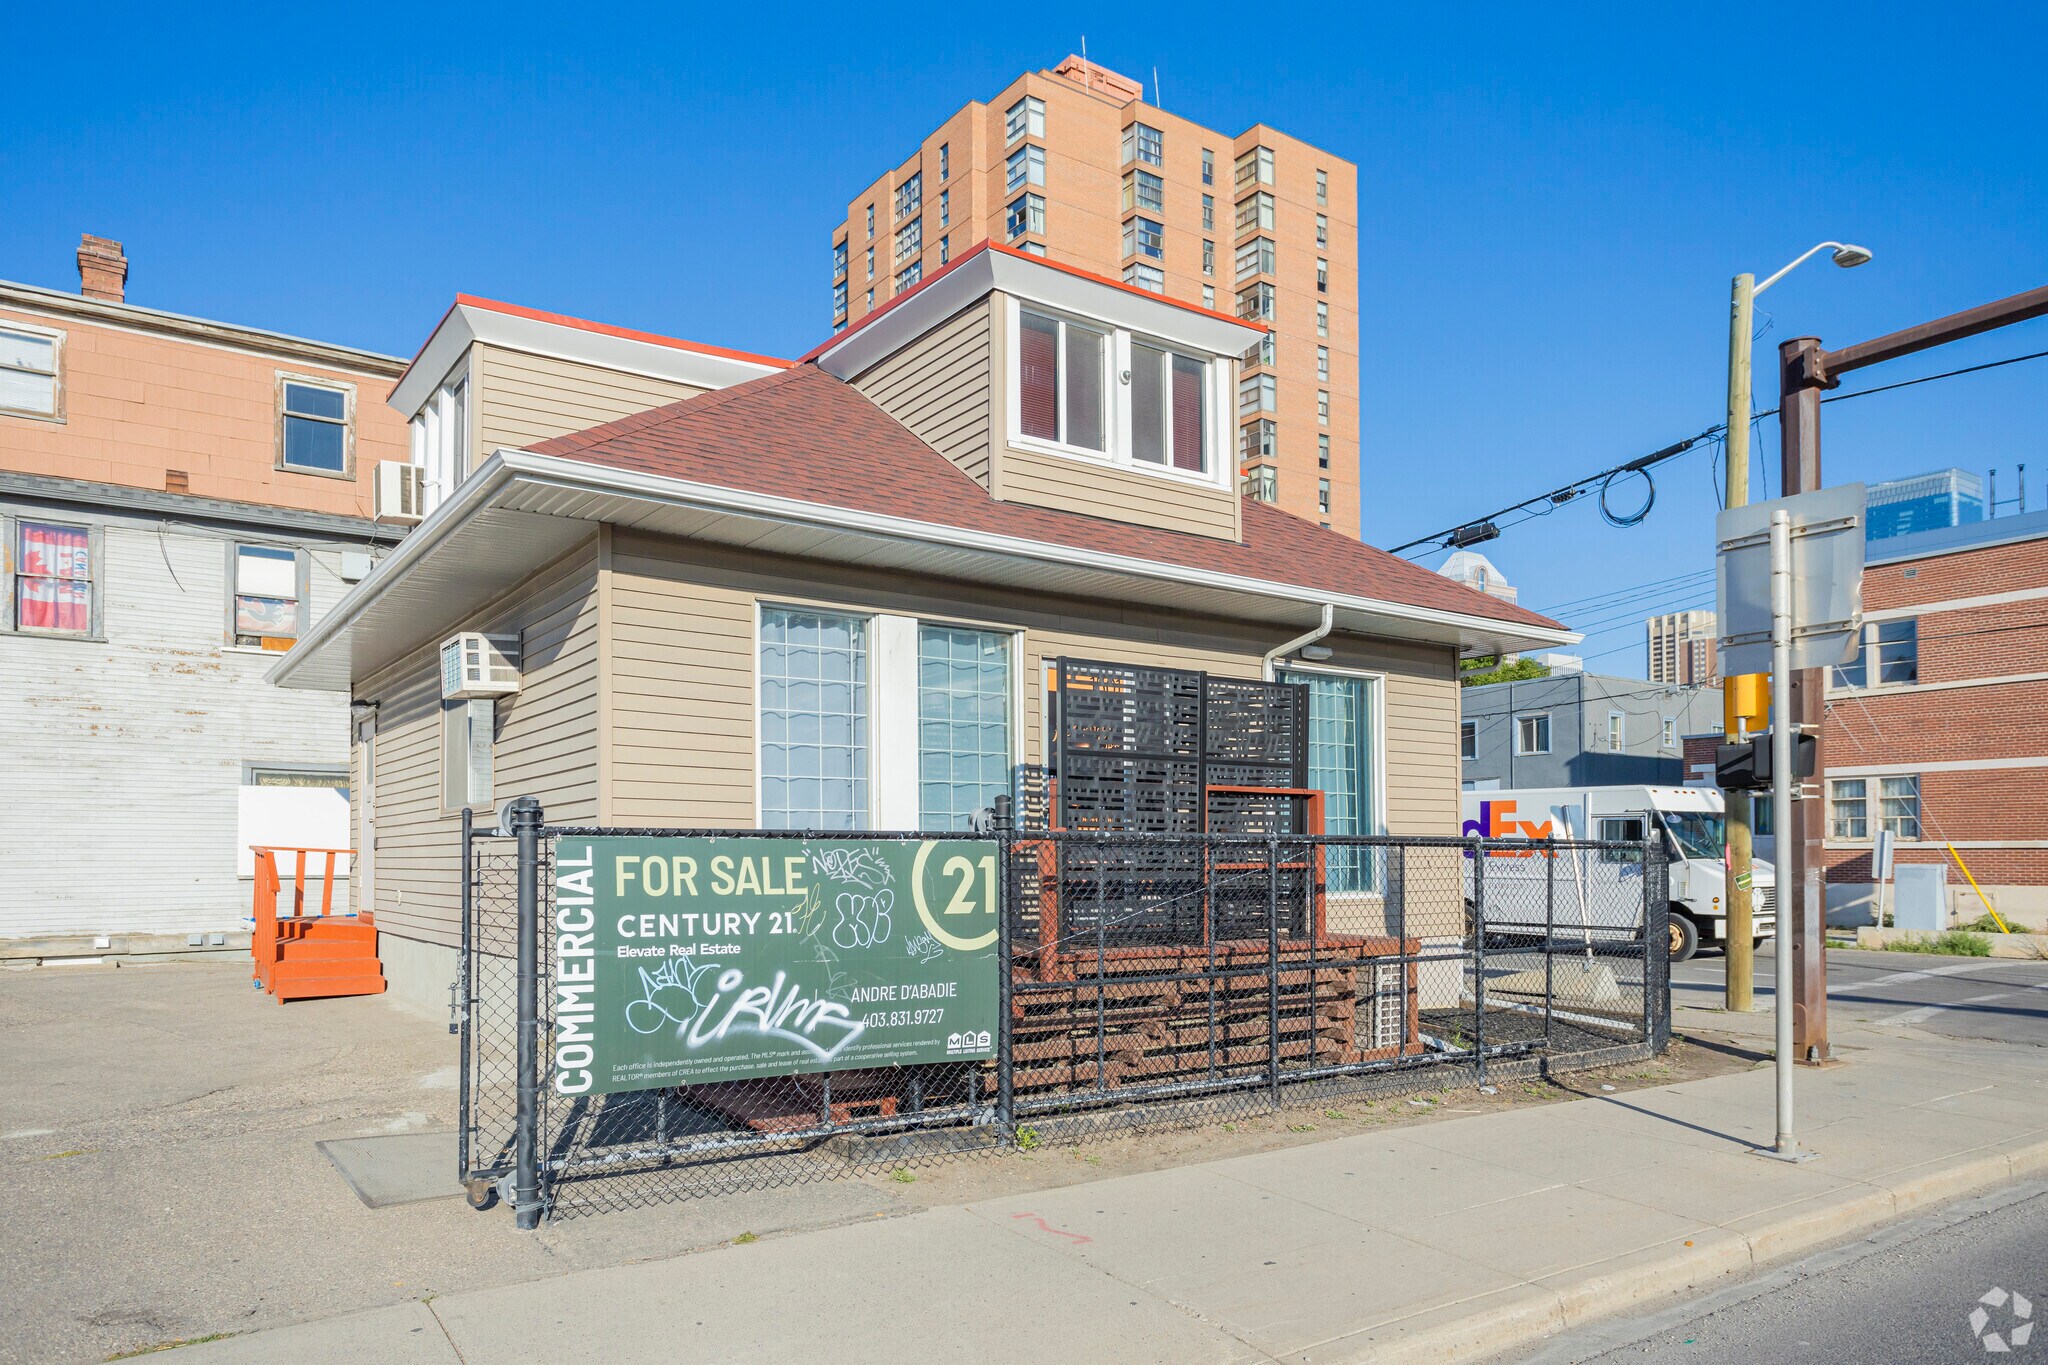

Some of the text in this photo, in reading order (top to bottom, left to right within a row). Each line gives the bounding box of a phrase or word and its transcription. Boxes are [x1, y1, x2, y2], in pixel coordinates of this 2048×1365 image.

[1462, 800, 1559, 858] dEx
[616, 856, 808, 896] FOR SALE
[943, 856, 995, 914] 21
[617, 913, 761, 937] CENTURY
[617, 943, 741, 957] Elevate Real Estate
[556, 846, 594, 1094] COMMERCIAL
[851, 982, 957, 1003] ANDRE D'ABADIE
[862, 1008, 944, 1028] 403.831.9727
[629, 1062, 646, 1070] office
[653, 1058, 693, 1068] independently
[862, 1042, 892, 1051] professional
[643, 1071, 671, 1079] members
[679, 1068, 694, 1076] CREA
[833, 1055, 844, 1063] part
